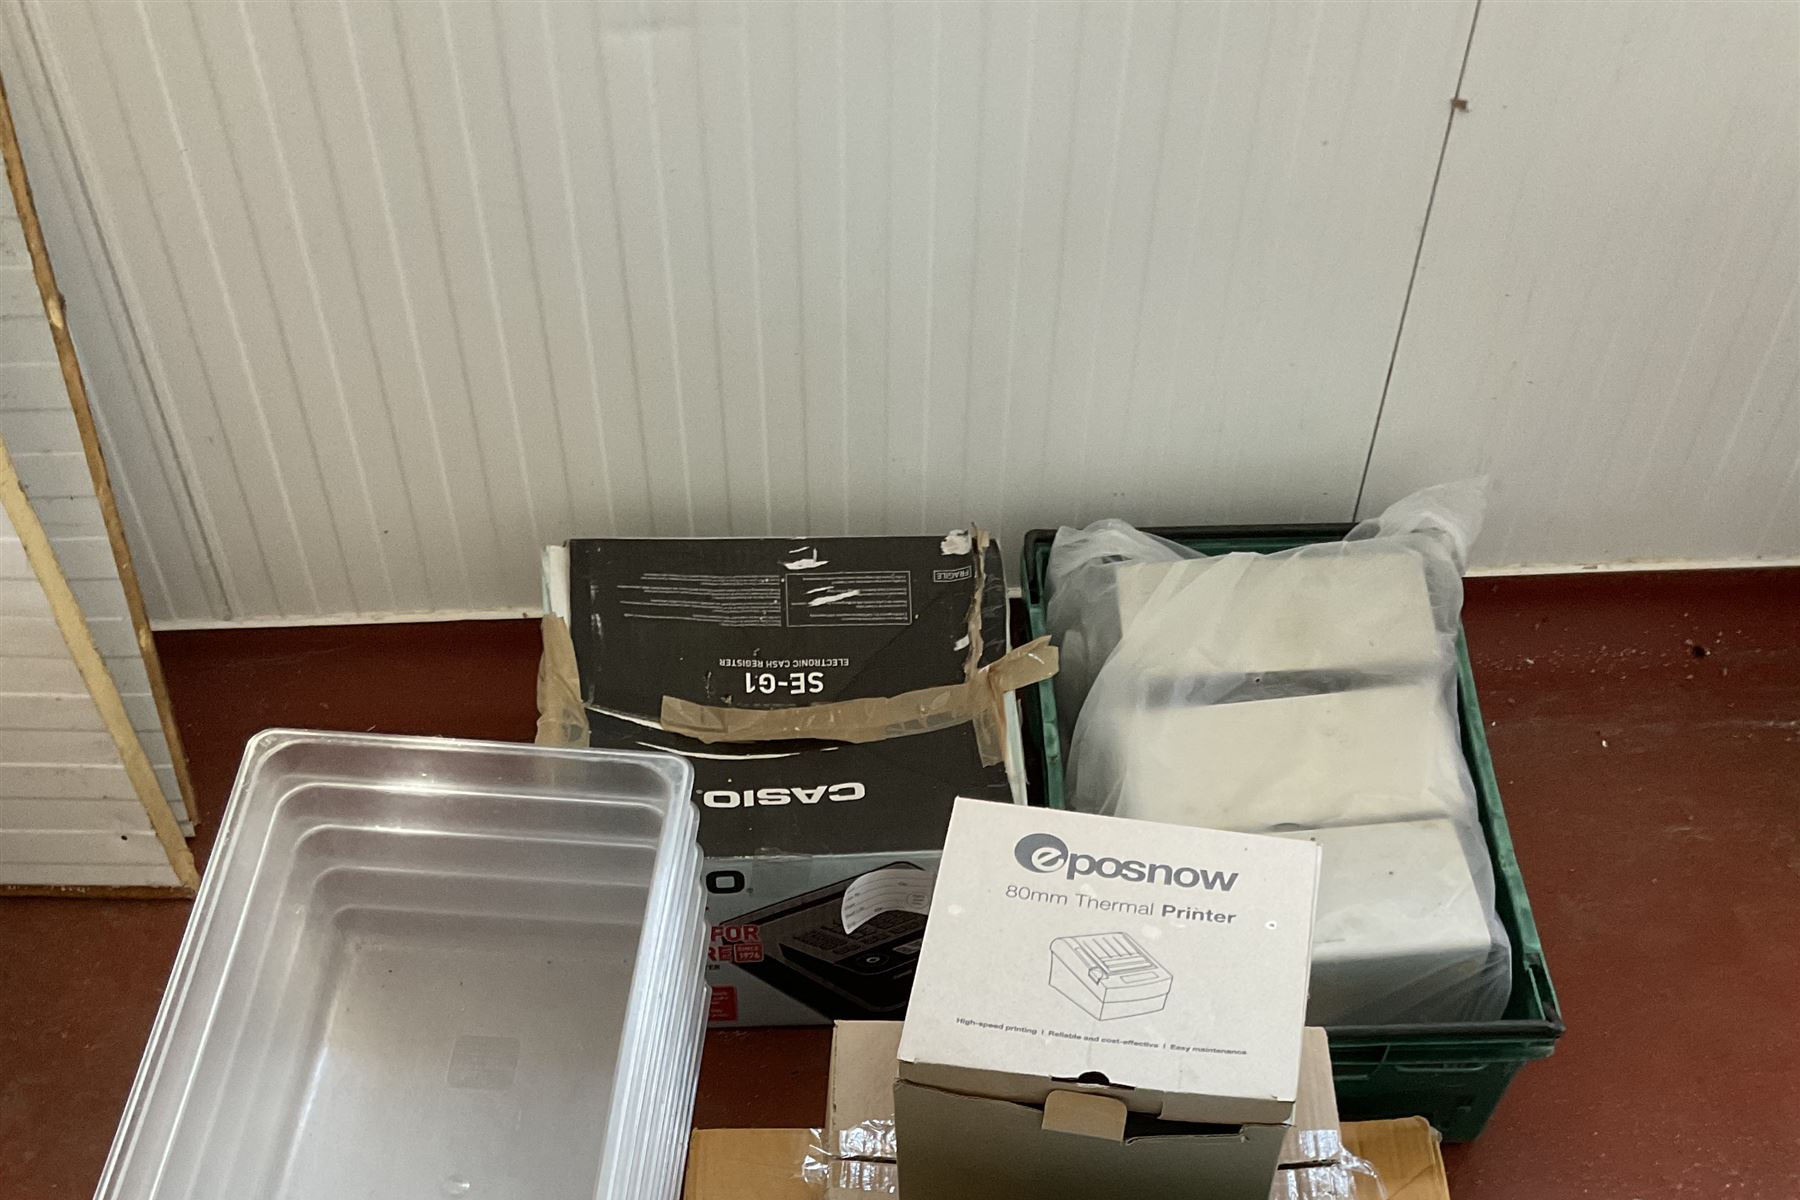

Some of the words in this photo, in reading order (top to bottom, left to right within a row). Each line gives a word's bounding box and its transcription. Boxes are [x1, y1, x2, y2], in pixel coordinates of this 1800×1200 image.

[936, 569, 970, 580] FRAGILE
[719, 658, 763, 668] REGISTER
[766, 659, 790, 668] CASH
[793, 658, 849, 667] ELECTRONIC
[745, 671, 824, 695] SE-G1
[703, 782, 866, 808] CASIO
[1014, 832, 1239, 892] eposnow
[1005, 884, 1068, 906] 80mm
[1075, 893, 1155, 916] Thermal
[1161, 904, 1237, 924] Printer
[710, 925, 760, 942] FOR
[956, 1016, 1004, 1031] High-speed
[1005, 1024, 1038, 1036] printing
[1048, 1030, 1082, 1041] Reliable
[1101, 1037, 1159, 1049] cost-effective
[1170, 1044, 1191, 1053] Easy
[1192, 1046, 1247, 1056] maintenance
